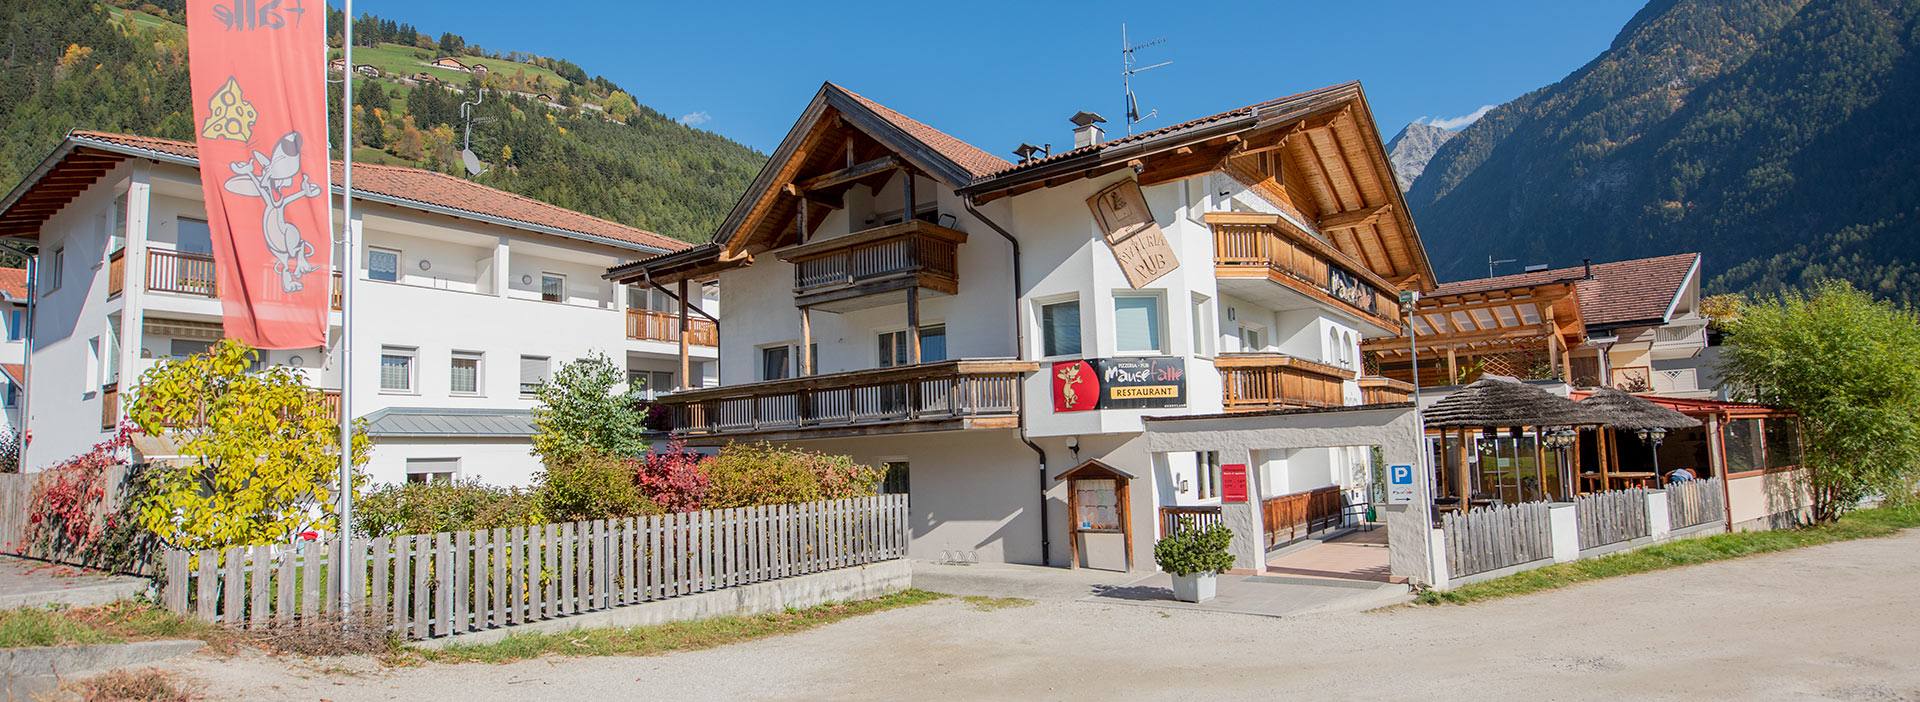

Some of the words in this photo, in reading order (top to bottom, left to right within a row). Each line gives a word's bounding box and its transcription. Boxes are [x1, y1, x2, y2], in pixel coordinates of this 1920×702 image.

[1134, 254, 1166, 279] PUB
[1116, 387, 1173, 397] RESTAURANT
[1395, 467, 1408, 483] P
